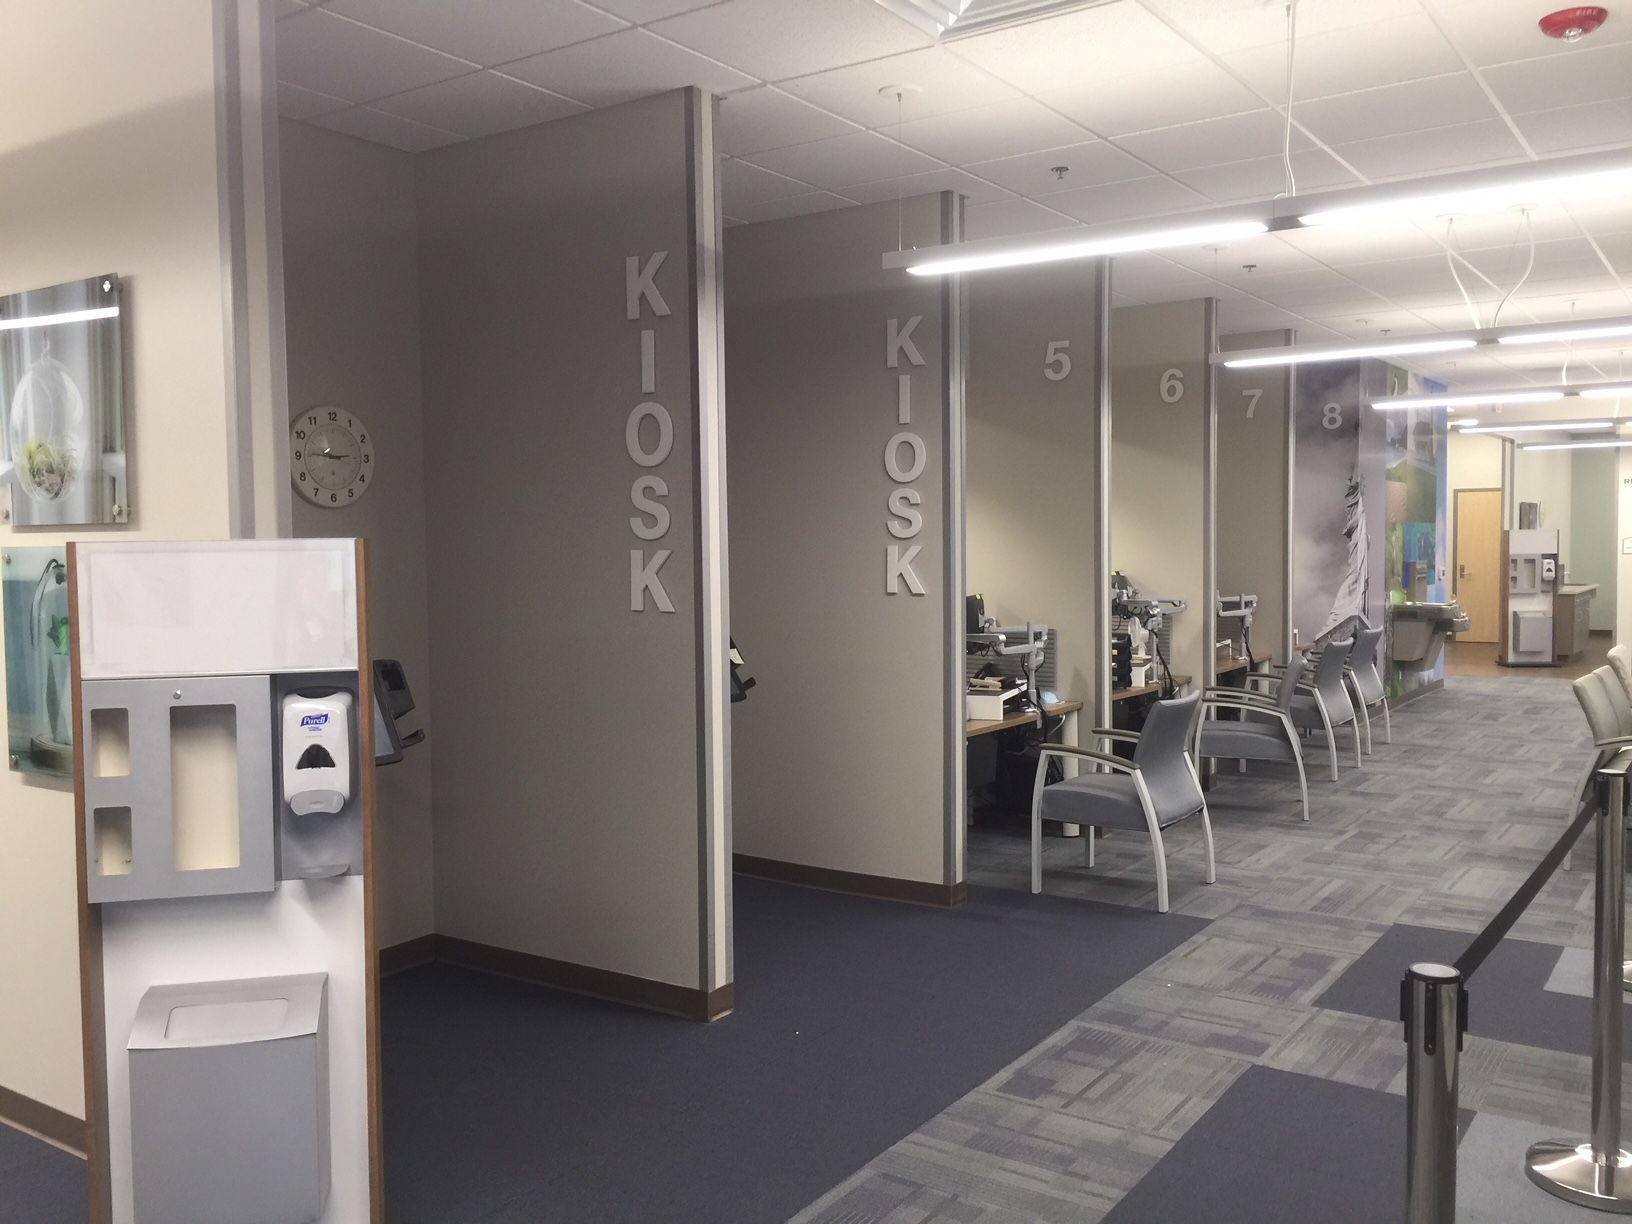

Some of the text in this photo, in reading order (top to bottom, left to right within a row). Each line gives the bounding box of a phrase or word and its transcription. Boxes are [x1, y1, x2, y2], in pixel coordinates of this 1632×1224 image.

[1043, 340, 1072, 381] 5
[1159, 368, 1184, 403] 6
[1242, 389, 1263, 418] 7
[328, 412, 337, 421] 12
[1321, 402, 1343, 430] 8
[308, 416, 317, 426] 11
[348, 419, 352, 428] 1
[295, 430, 306, 440] 10
[625, 250, 676, 613] KIOSK
[360, 434, 366, 443] 2
[295, 451, 302, 460] 9
[363, 454, 370, 463] 3
[884, 315, 926, 596] KIOSK
[299, 472, 306, 481] 8
[359, 474, 365, 484] 4
[313, 488, 319, 496] 7
[348, 489, 354, 497] 5
[330, 493, 337, 502] 6
